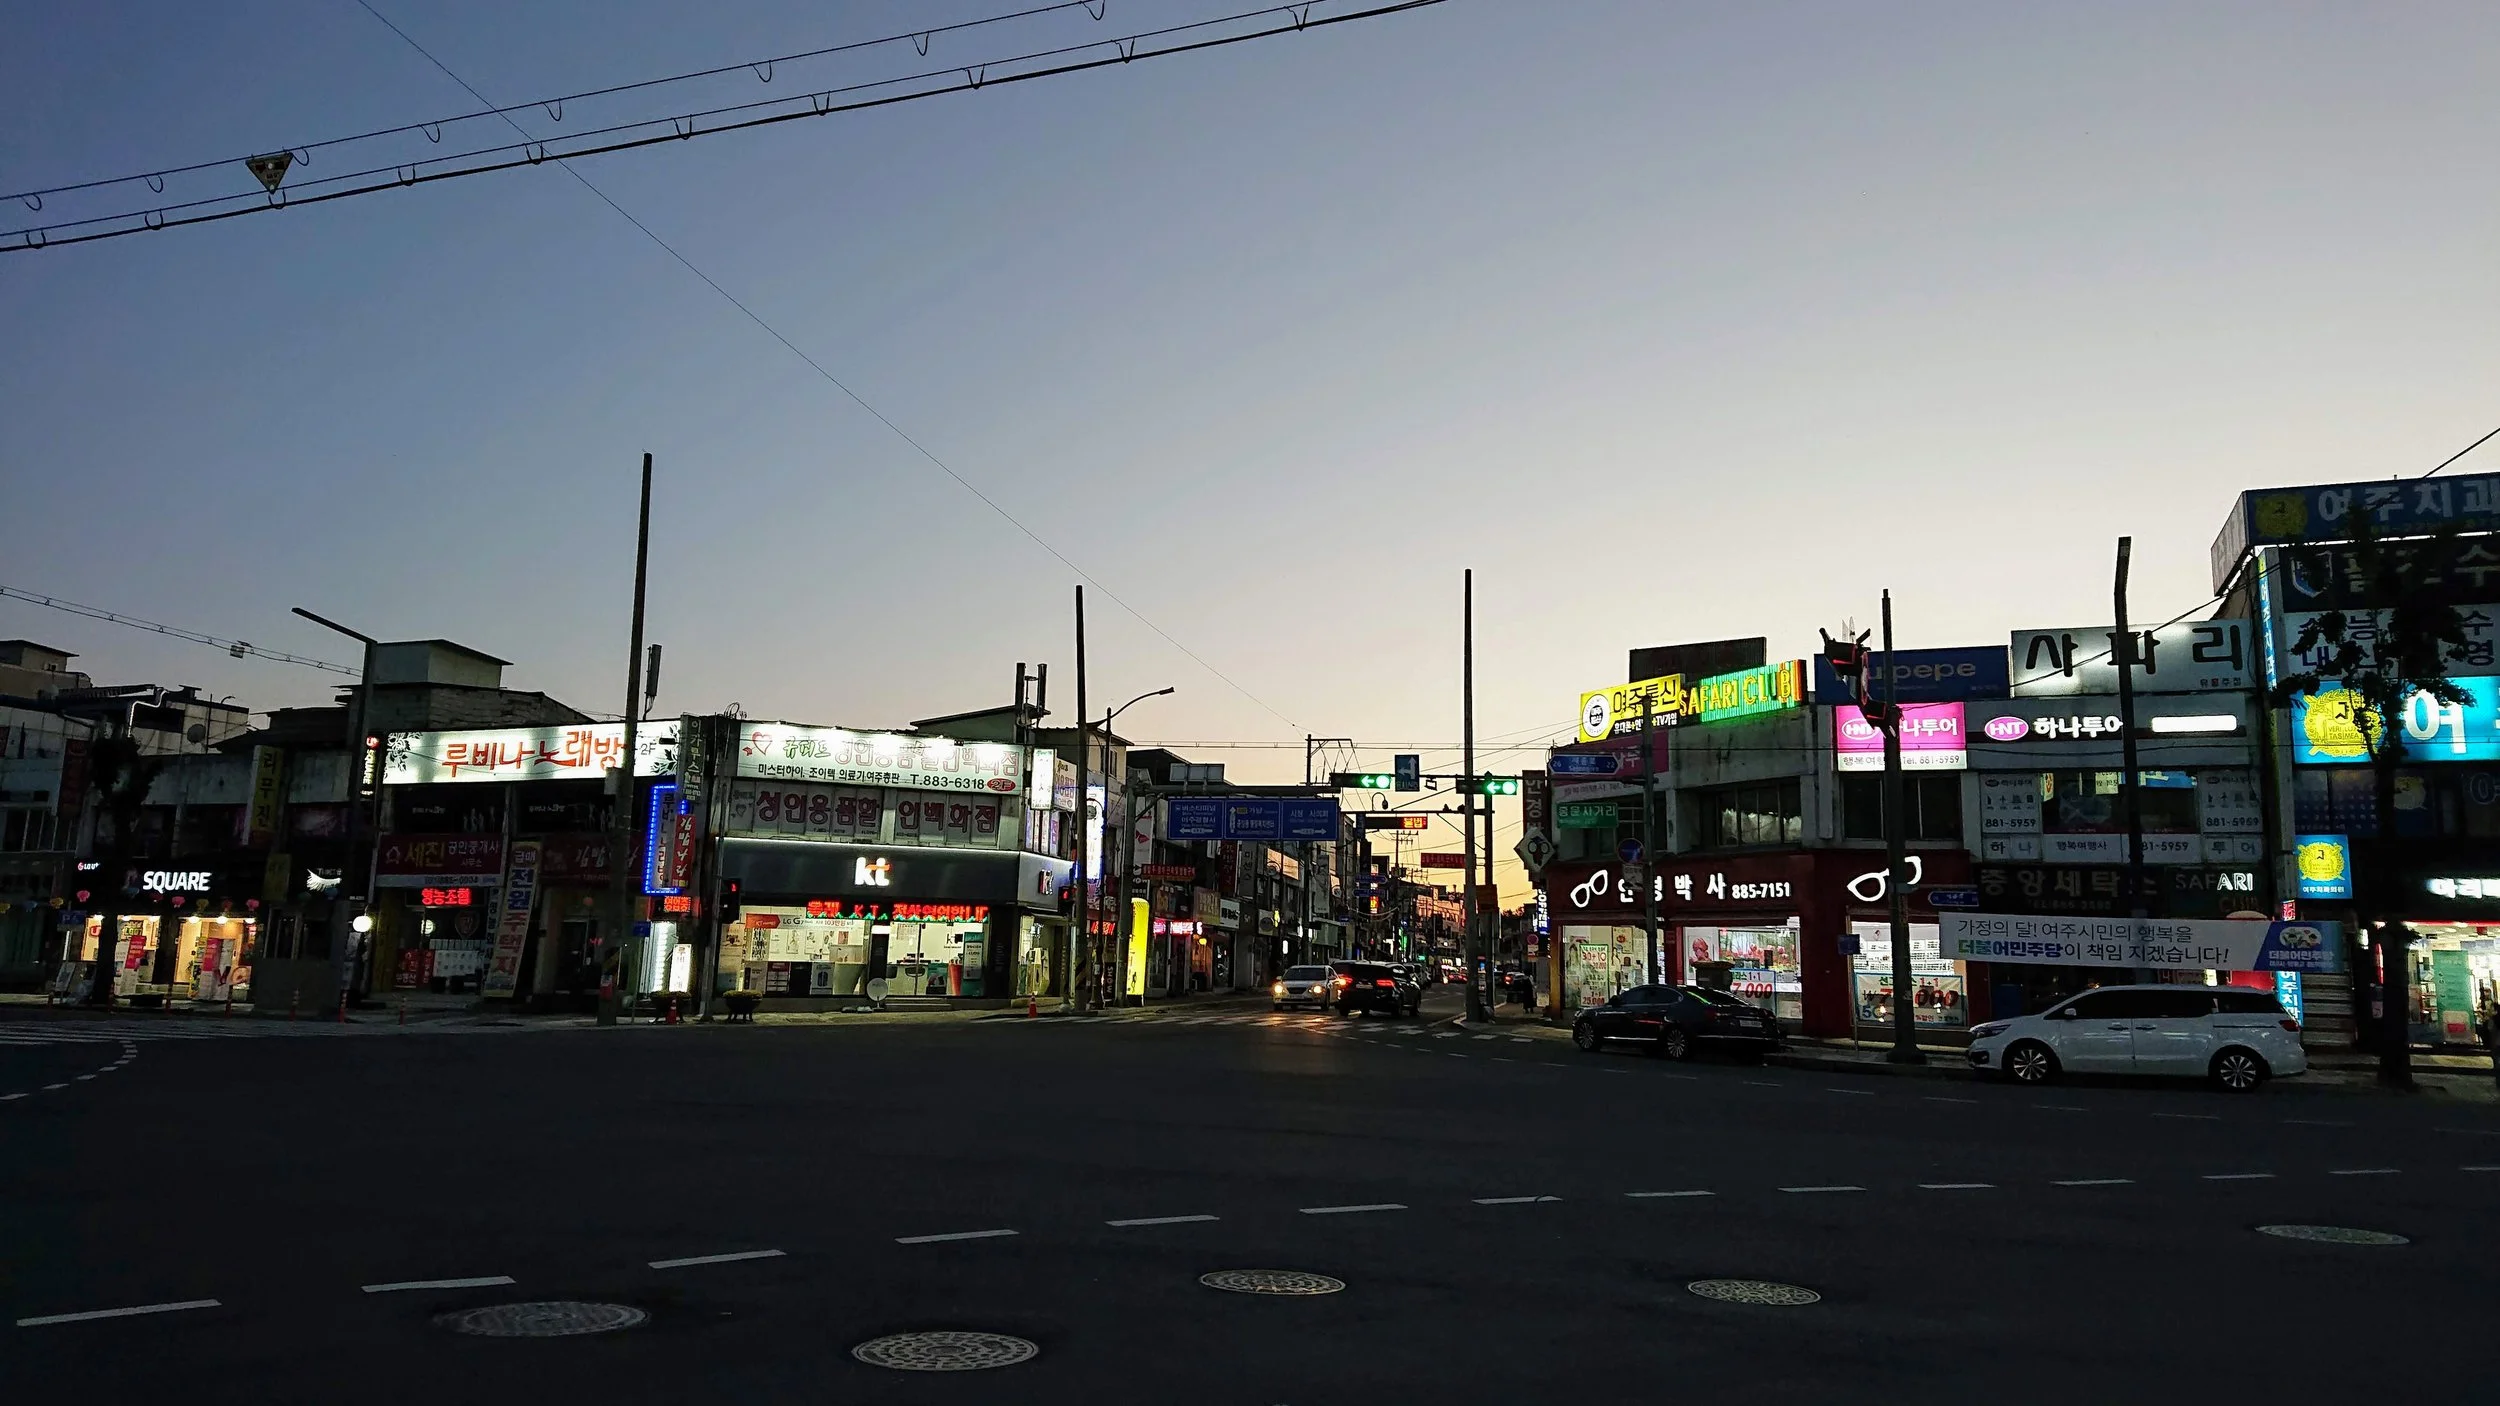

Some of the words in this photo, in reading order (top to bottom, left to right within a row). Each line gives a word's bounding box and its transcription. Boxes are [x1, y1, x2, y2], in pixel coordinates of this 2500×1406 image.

[2026, 624, 2243, 677] 사파리
[1612, 679, 1678, 715] 여주통신
[1679, 682, 1738, 718] SAFARI
[1899, 717, 1958, 738] 나투어
[2034, 715, 2123, 738] 하나투어
[442, 741, 535, 778] 루비나
[534, 731, 630, 773] 노래방
[910, 774, 985, 790] T.883-6318
[1985, 817, 2036, 829] 881-5959
[142, 872, 211, 894] SQUARE
[854, 857, 891, 887] kt
[2175, 873, 2254, 892] SAFARI
[1731, 881, 1792, 900] 885-7151
[1957, 919, 2010, 938] 가정의
[2014, 921, 2038, 939] 달!
[2041, 922, 2133, 943] 여주시민의
[2136, 924, 2194, 944] 행복을
[1957, 939, 2082, 960] 더불어민주당이
[2086, 942, 2124, 961] 책임
[2129, 944, 2230, 966] 지겠습니다!
